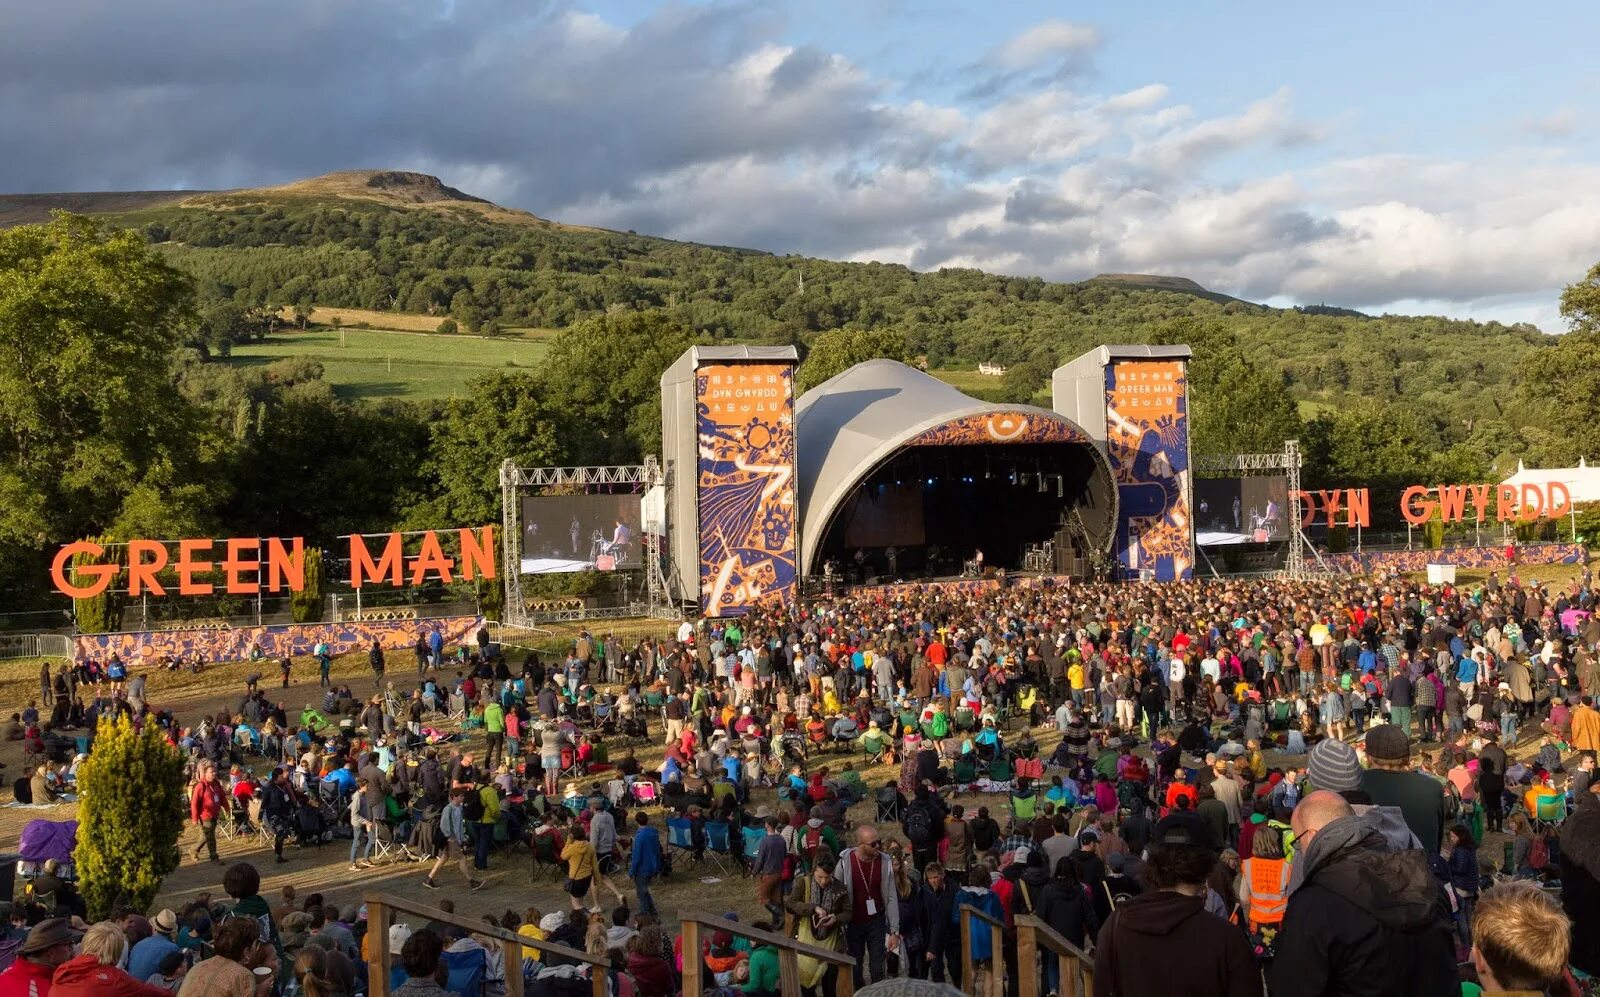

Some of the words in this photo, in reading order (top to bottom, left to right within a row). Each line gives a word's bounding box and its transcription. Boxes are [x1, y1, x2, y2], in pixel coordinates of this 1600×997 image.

[712, 389, 732, 399] DYN
[735, 388, 778, 398] GWYRDD
[1119, 384, 1150, 394] GREEN
[1153, 384, 1173, 393] MAN
[1288, 488, 1370, 529] DYN
[1400, 481, 1572, 525] GWYRDD
[50, 536, 305, 599] GREEN
[349, 526, 497, 589] MAN
